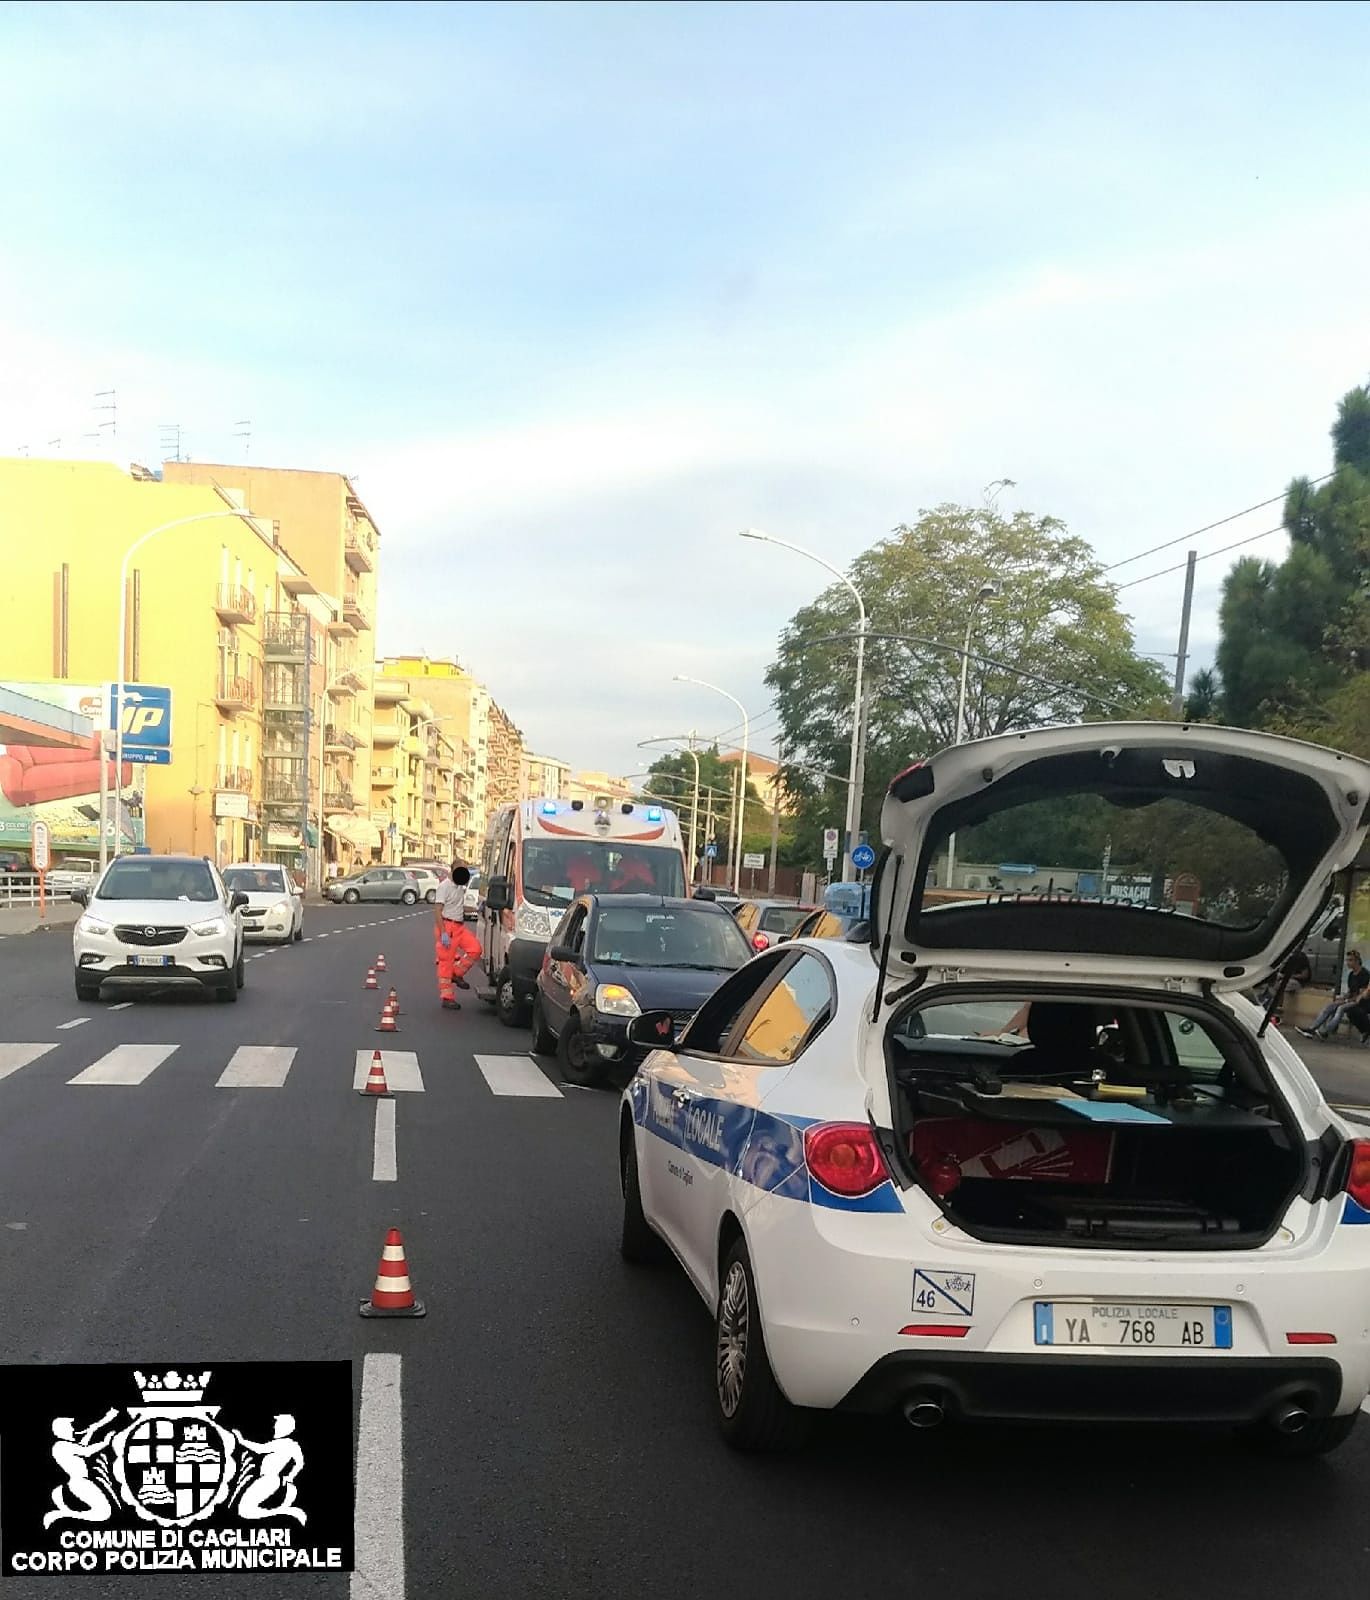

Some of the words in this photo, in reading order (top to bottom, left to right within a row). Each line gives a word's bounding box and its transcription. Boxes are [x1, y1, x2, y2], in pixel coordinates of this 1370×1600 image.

[121, 752, 144, 761] RUPPO
[686, 1106, 724, 1152] LOCALE
[916, 1289, 936, 1308] 46
[1092, 1306, 1132, 1318] POLIZIA
[1138, 1306, 1179, 1319] LOCALE
[1065, 1318, 1091, 1343] YA
[1118, 1319, 1156, 1344] 768
[1181, 1321, 1204, 1346] AB
